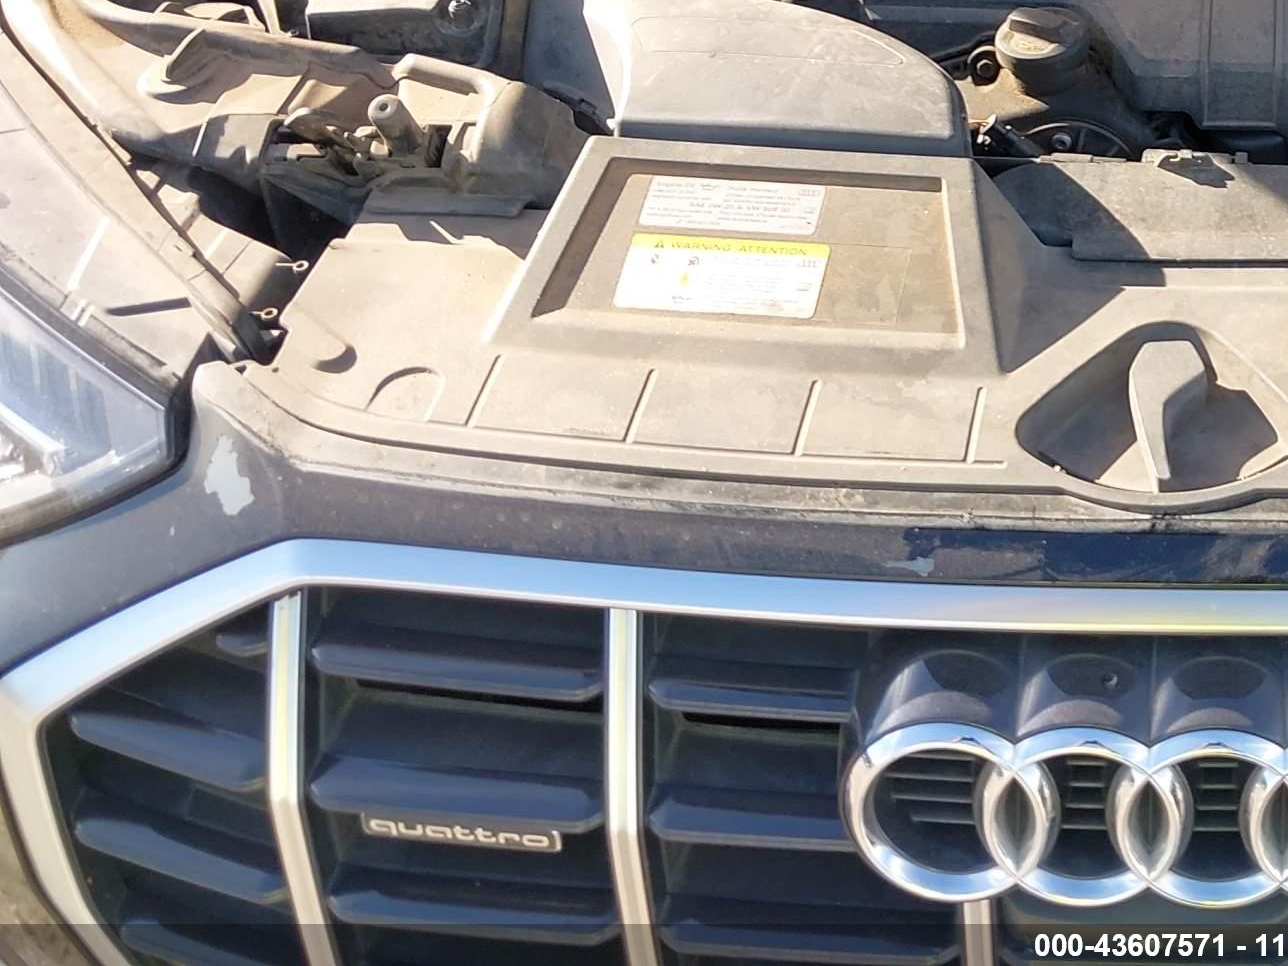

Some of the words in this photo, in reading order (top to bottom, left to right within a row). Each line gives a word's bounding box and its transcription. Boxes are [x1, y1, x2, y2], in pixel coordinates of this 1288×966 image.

[671, 241, 732, 252] WARNING
[739, 244, 809, 256] ATTENTION
[369, 818, 551, 848] quattro
